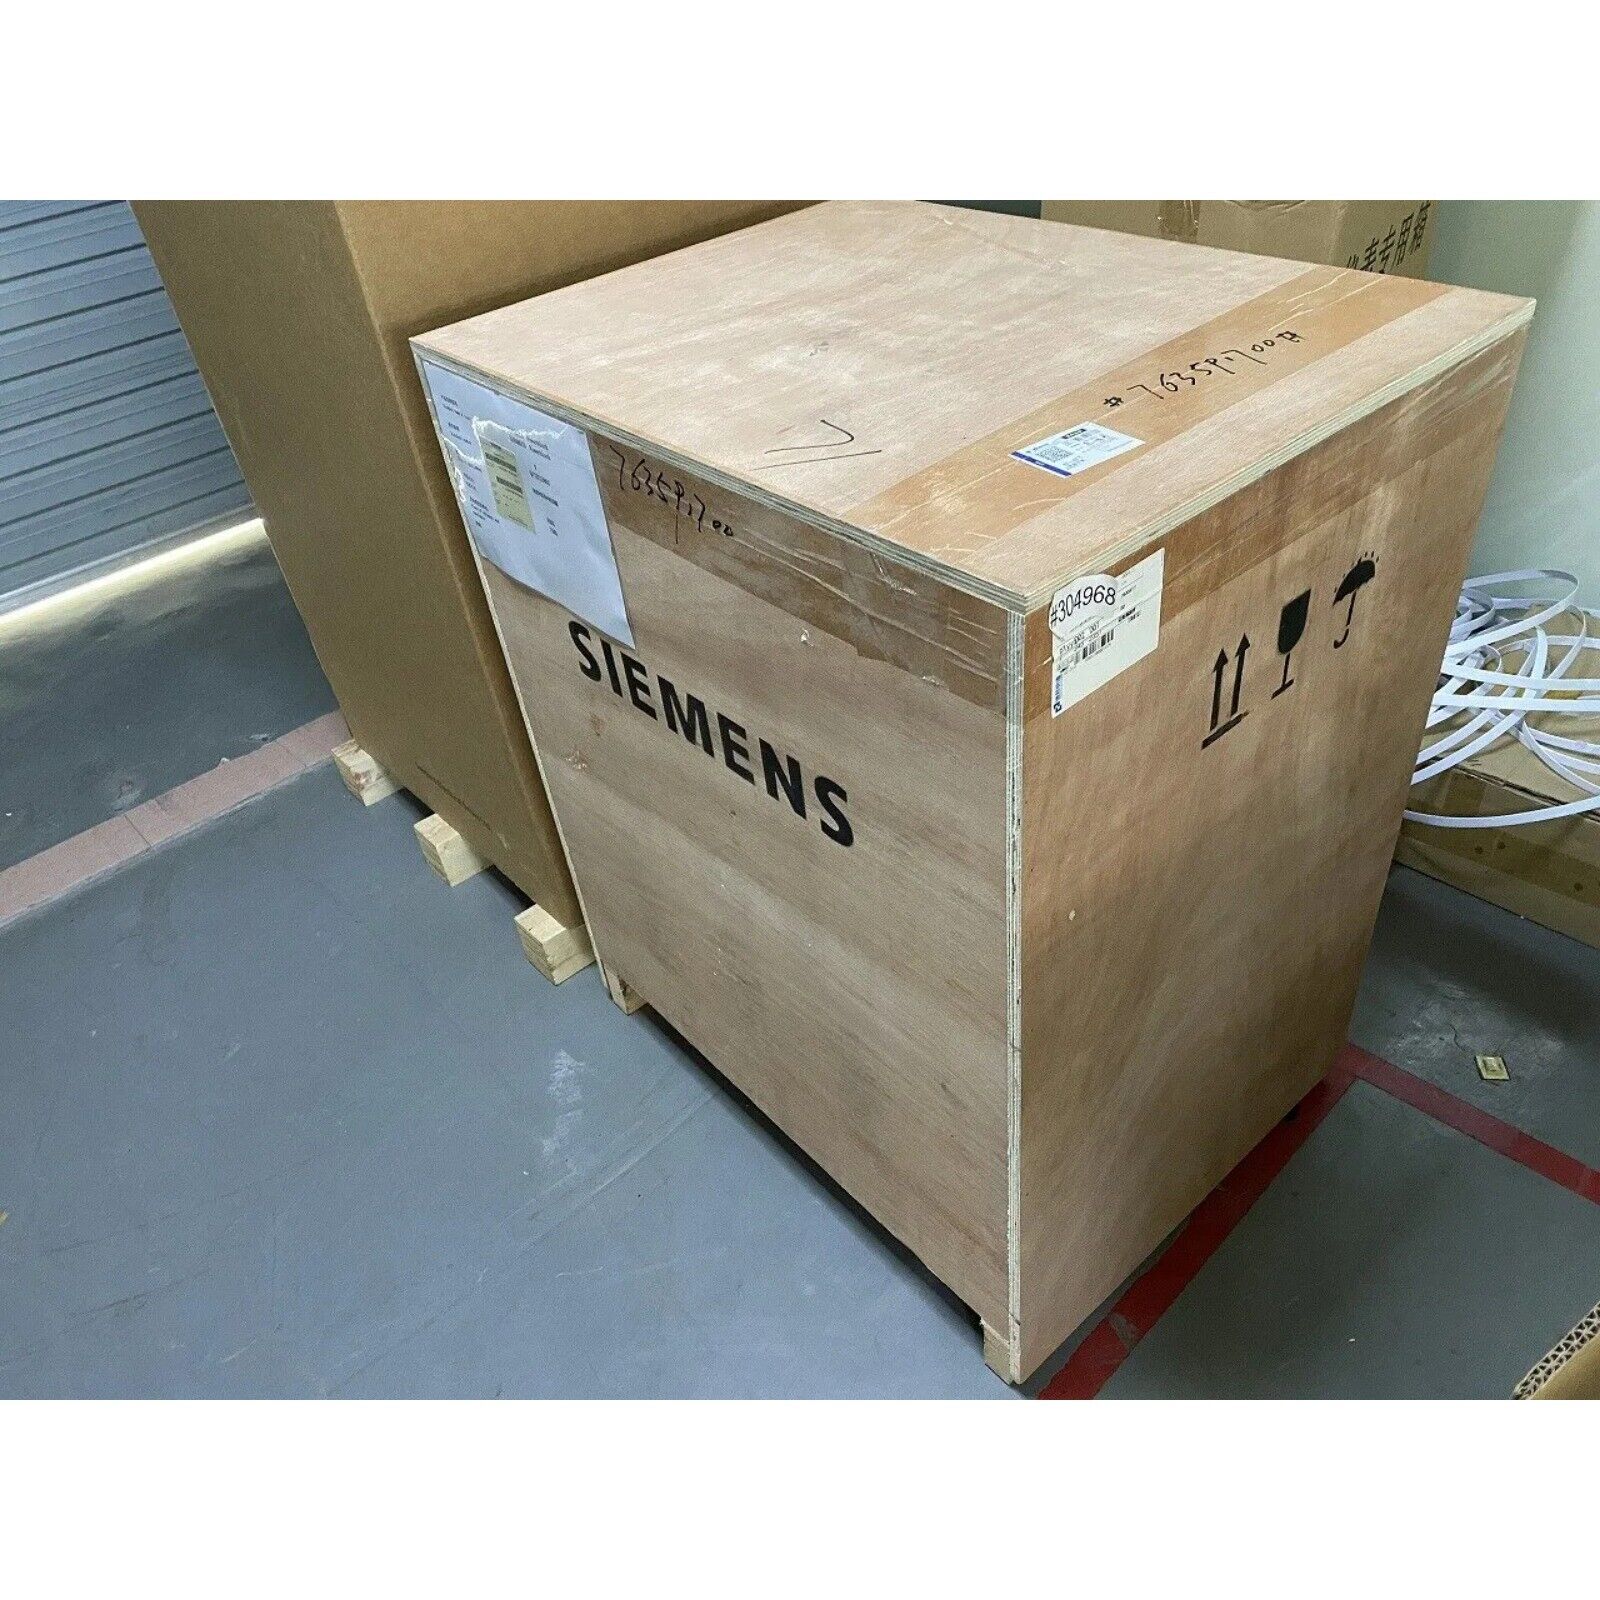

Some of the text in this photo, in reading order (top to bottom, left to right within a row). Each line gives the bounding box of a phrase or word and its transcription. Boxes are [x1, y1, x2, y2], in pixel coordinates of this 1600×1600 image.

[1346, 200, 1431, 275] 表专用箱
[1050, 584, 1116, 628] #304968
[568, 621, 854, 847] SIEMENS
